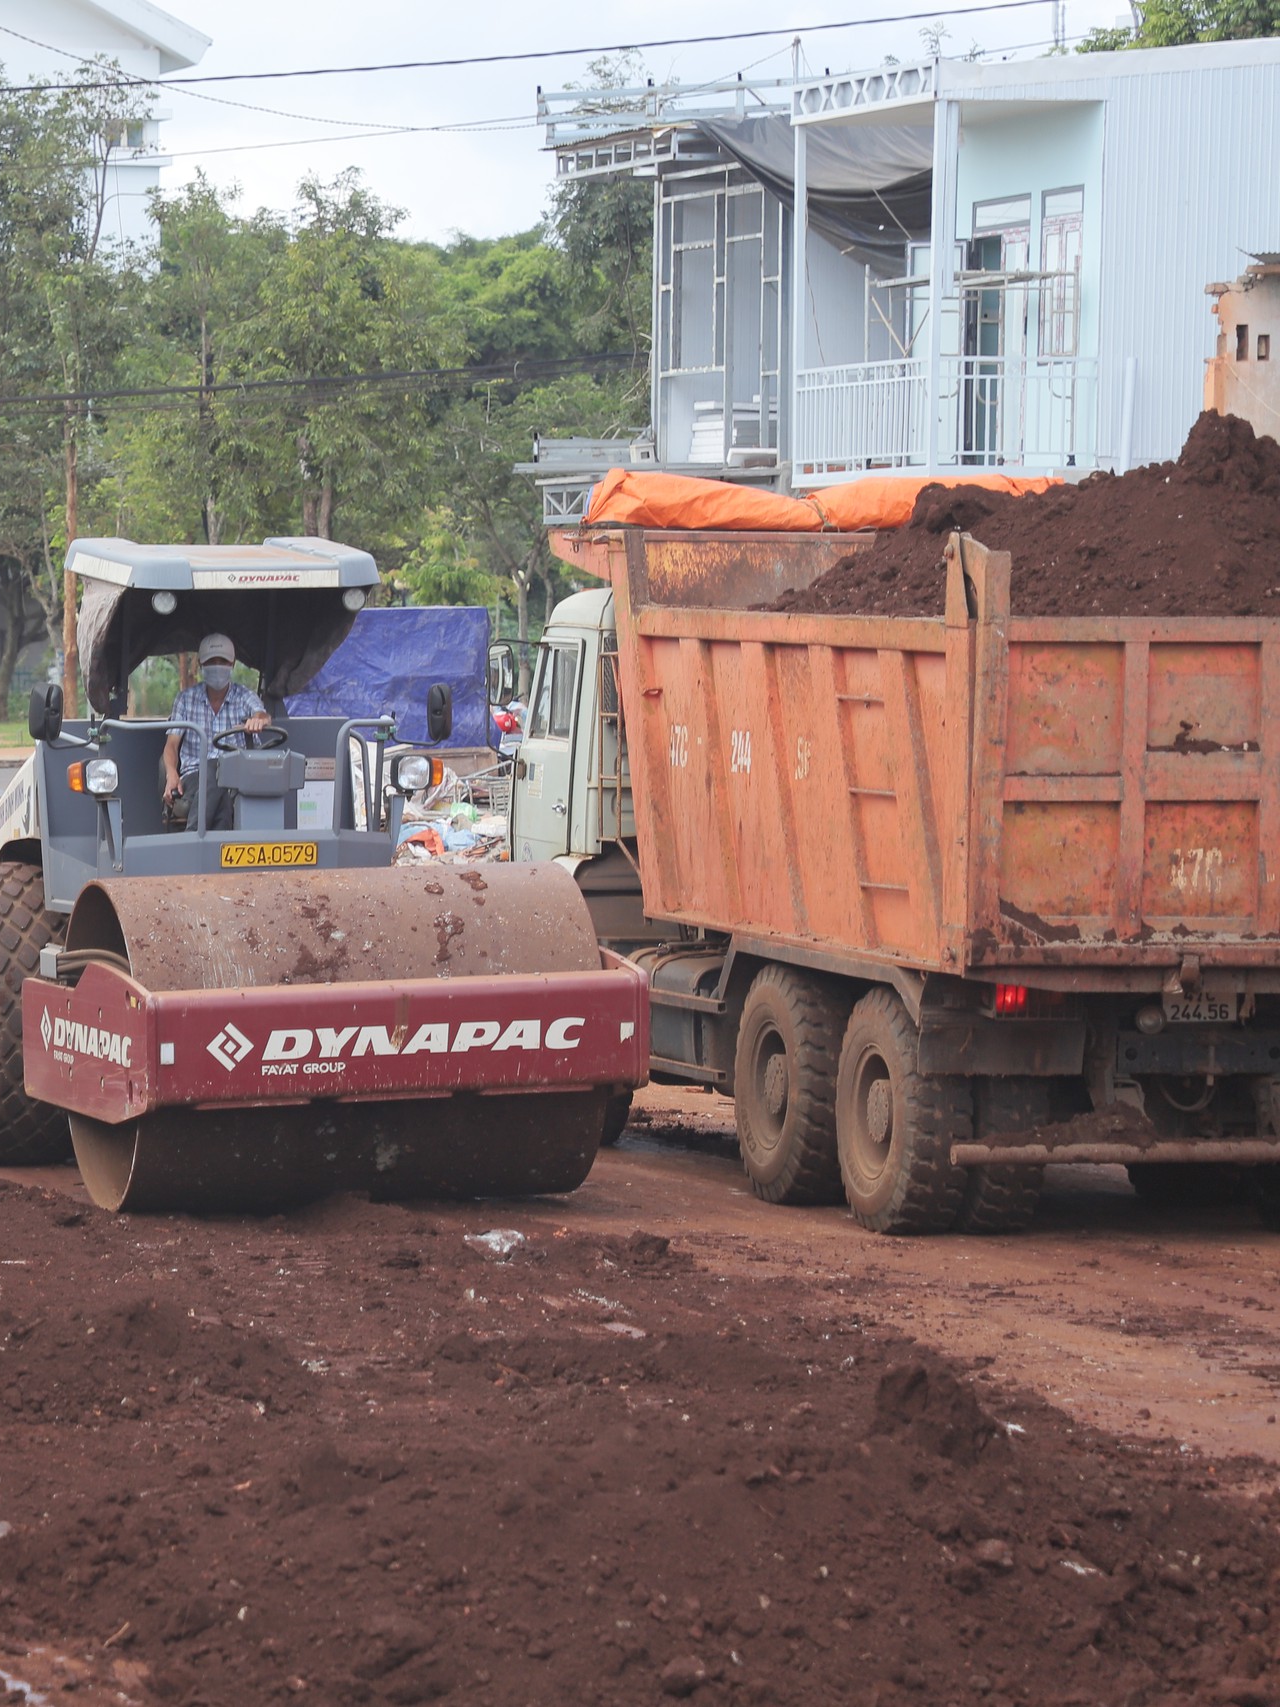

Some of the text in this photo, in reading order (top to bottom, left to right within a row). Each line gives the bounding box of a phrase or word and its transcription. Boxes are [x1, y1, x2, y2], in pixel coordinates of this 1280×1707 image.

[238, 574, 300, 583] DYNAPAC
[669, 724, 689, 769] 47C
[730, 729, 752, 775] 244
[1170, 1003, 1230, 1020] 244.56
[53, 1017, 132, 1068] DYNAPAC
[261, 1016, 586, 1061] DYNAPAC
[261, 1061, 346, 1076] FAYAT GROUP
